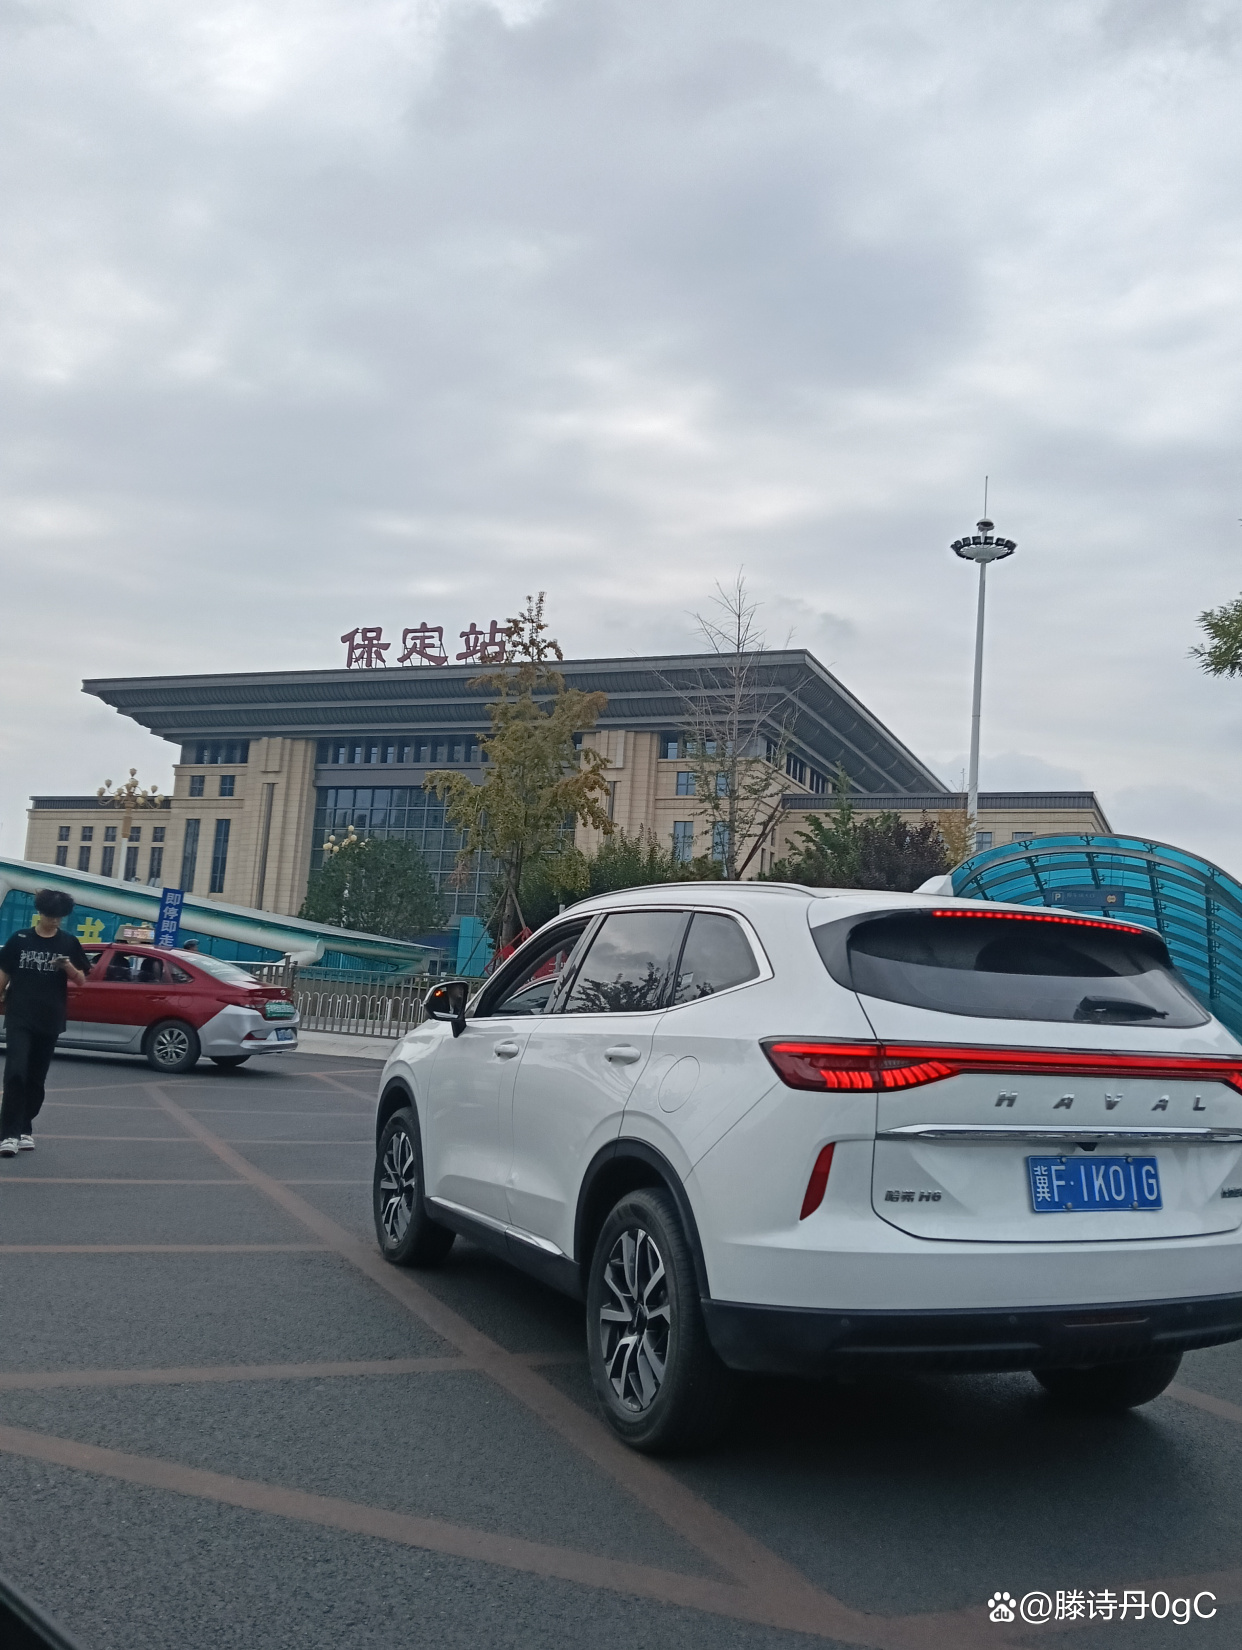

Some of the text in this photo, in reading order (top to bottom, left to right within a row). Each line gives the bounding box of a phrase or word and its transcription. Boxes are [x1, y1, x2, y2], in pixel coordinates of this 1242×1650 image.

[341, 620, 508, 668] 保定站
[159, 892, 181, 947] 即停即走
[995, 1089, 1207, 1111] HAVAL
